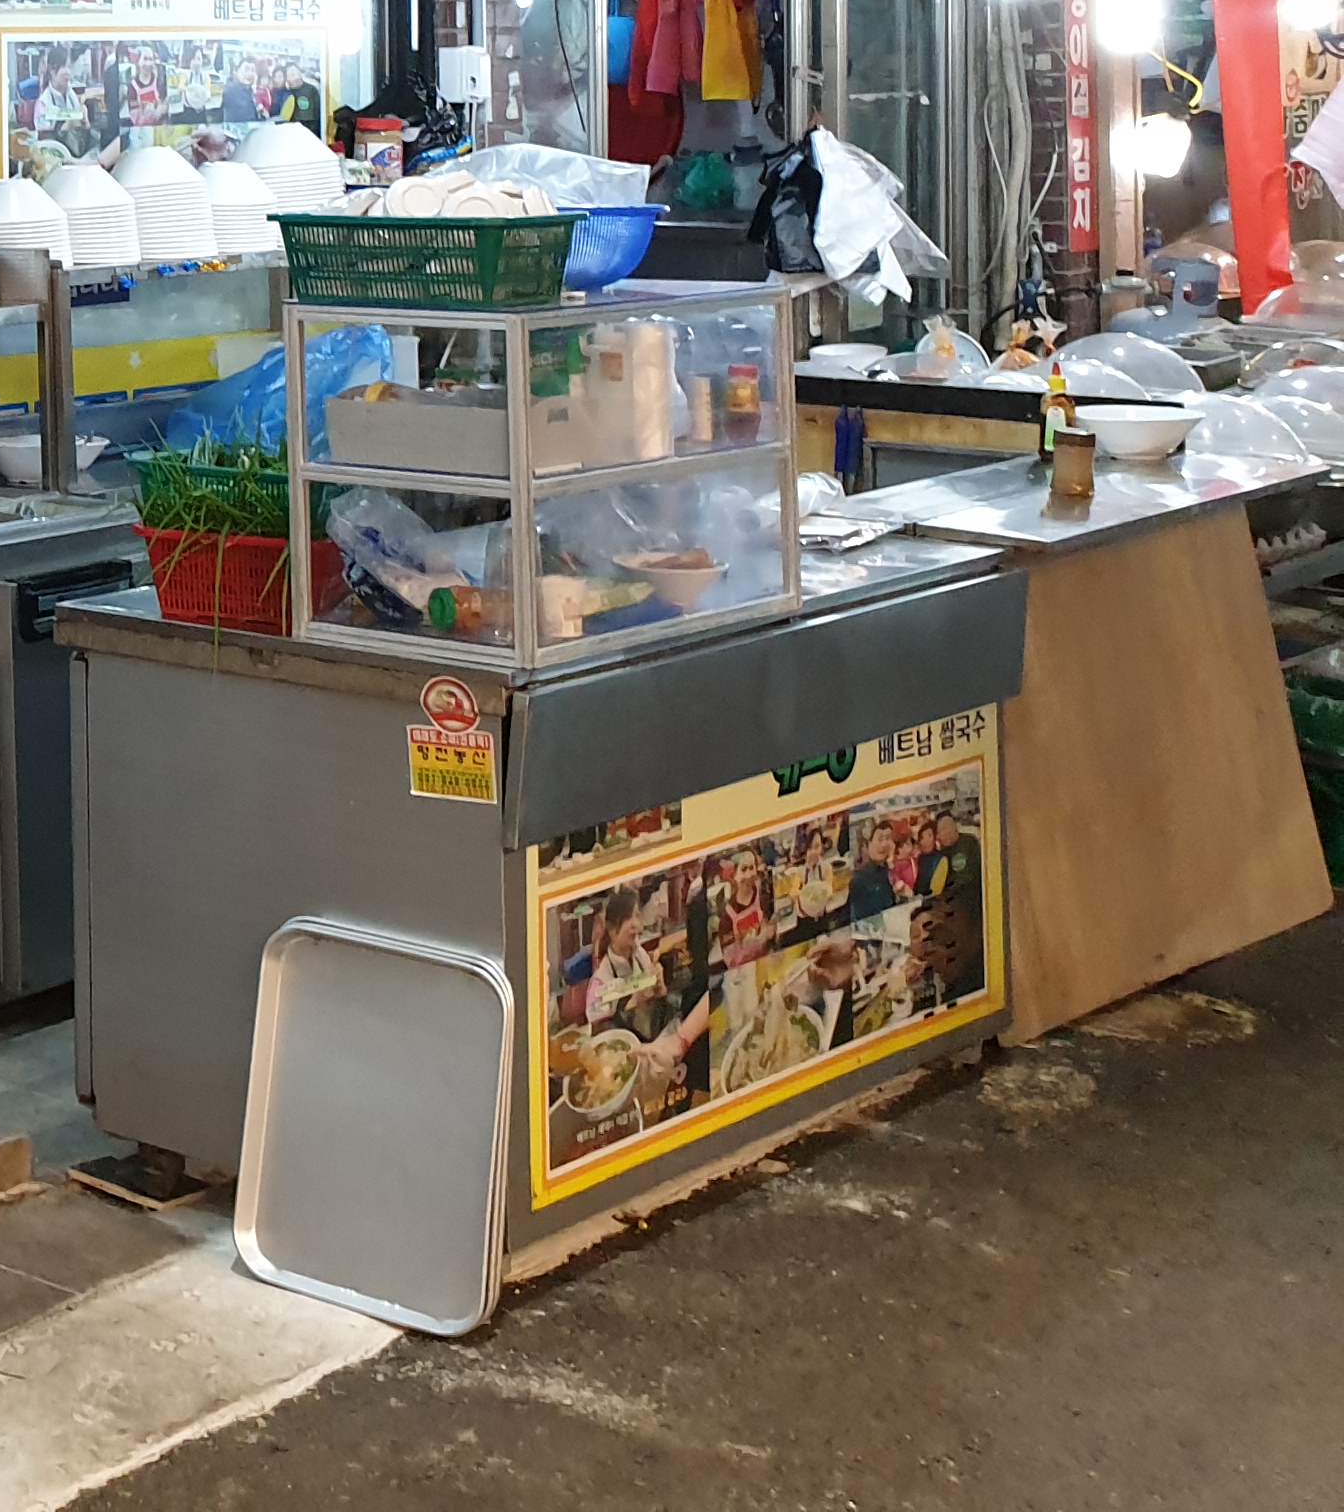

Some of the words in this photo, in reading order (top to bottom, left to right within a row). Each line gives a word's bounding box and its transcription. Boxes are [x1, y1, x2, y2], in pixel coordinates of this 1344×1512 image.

[213, 0, 263, 21] 베트남
[273, 0, 321, 22] 쌀국수
[1072, 137, 1090, 232] 김치
[878, 724, 932, 765] 베트남
[940, 710, 985, 750] 쌀국수
